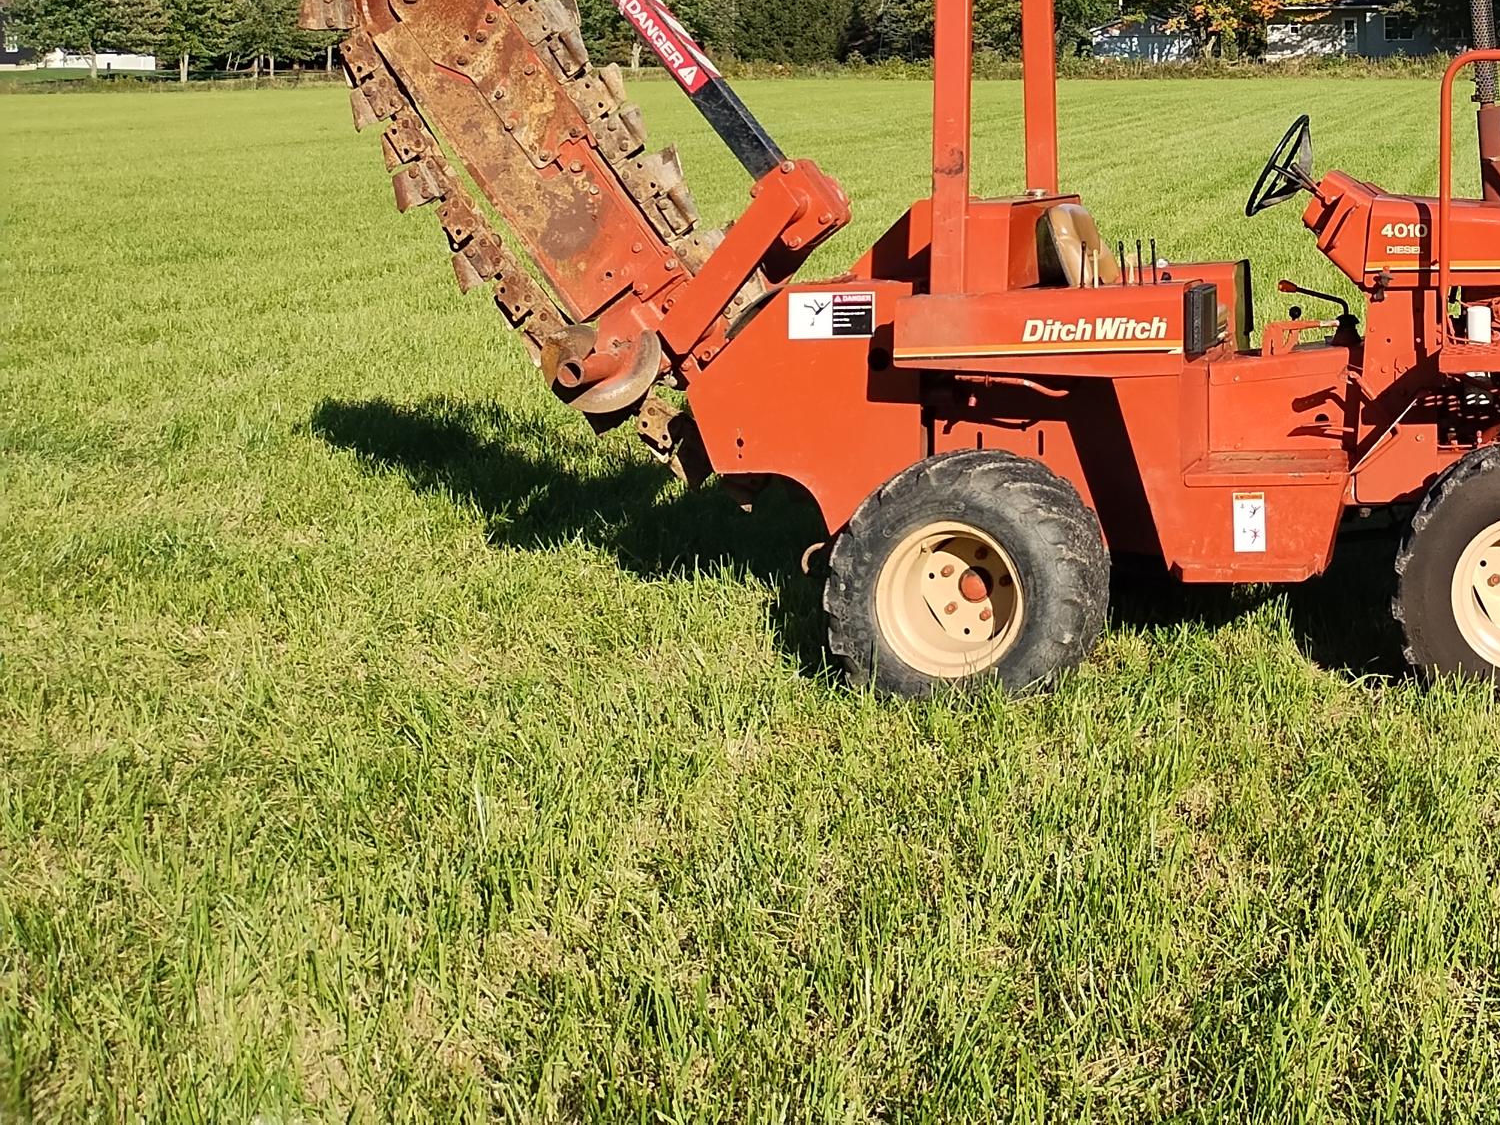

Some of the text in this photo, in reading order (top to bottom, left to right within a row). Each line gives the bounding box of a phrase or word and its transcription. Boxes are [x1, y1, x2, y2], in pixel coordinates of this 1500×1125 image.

[1381, 223, 1428, 238] 4010
[1021, 317, 1168, 342] Ditch Witch
